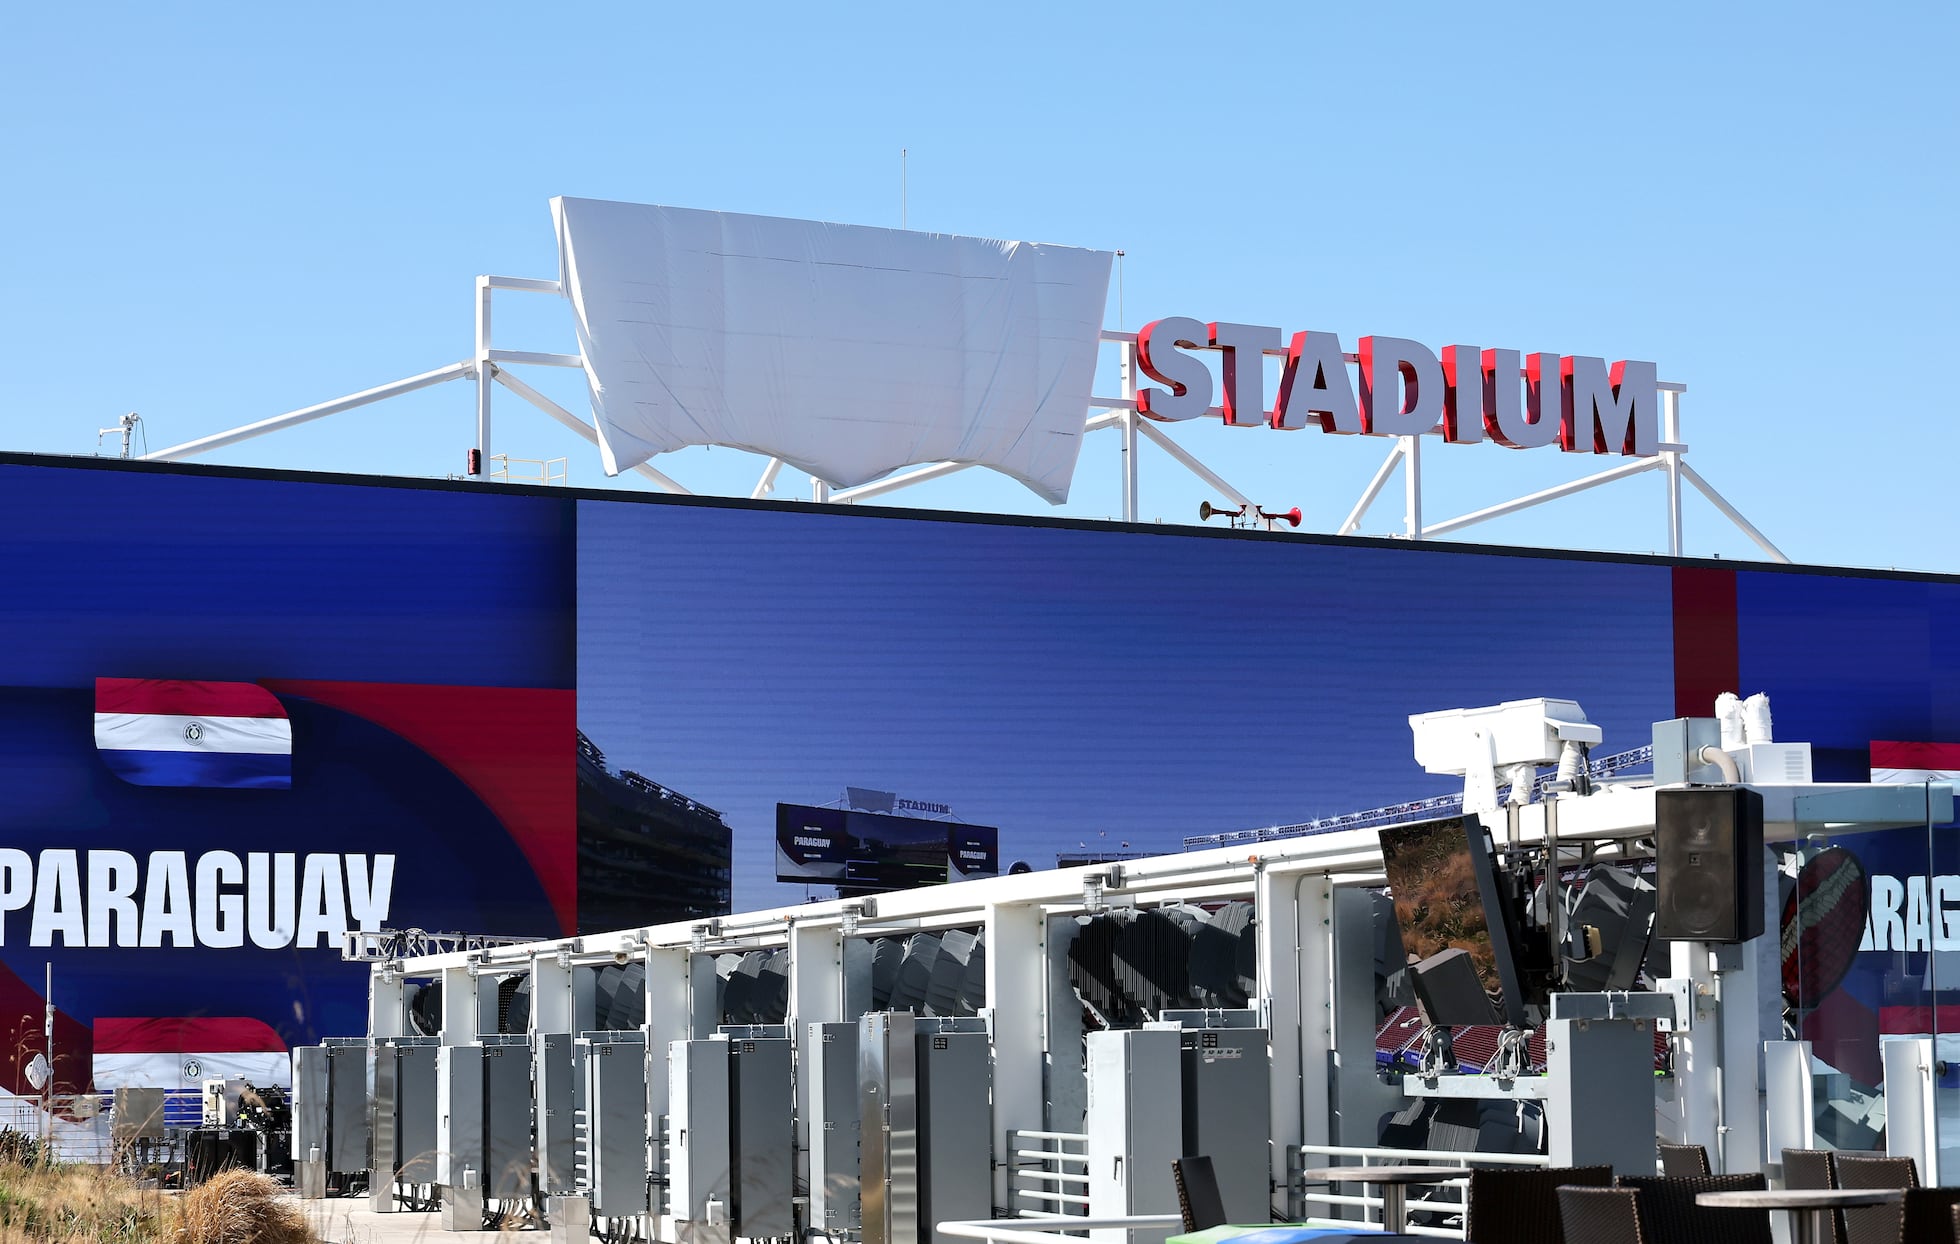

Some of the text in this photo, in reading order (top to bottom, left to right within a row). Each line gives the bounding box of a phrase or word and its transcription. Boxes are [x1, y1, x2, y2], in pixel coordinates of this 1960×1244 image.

[1137, 316, 1658, 457] STADIUM
[899, 799, 949, 814] STADIUM
[794, 836, 831, 848] PARAGUAY
[0, 847, 396, 950] PARAGUAY
